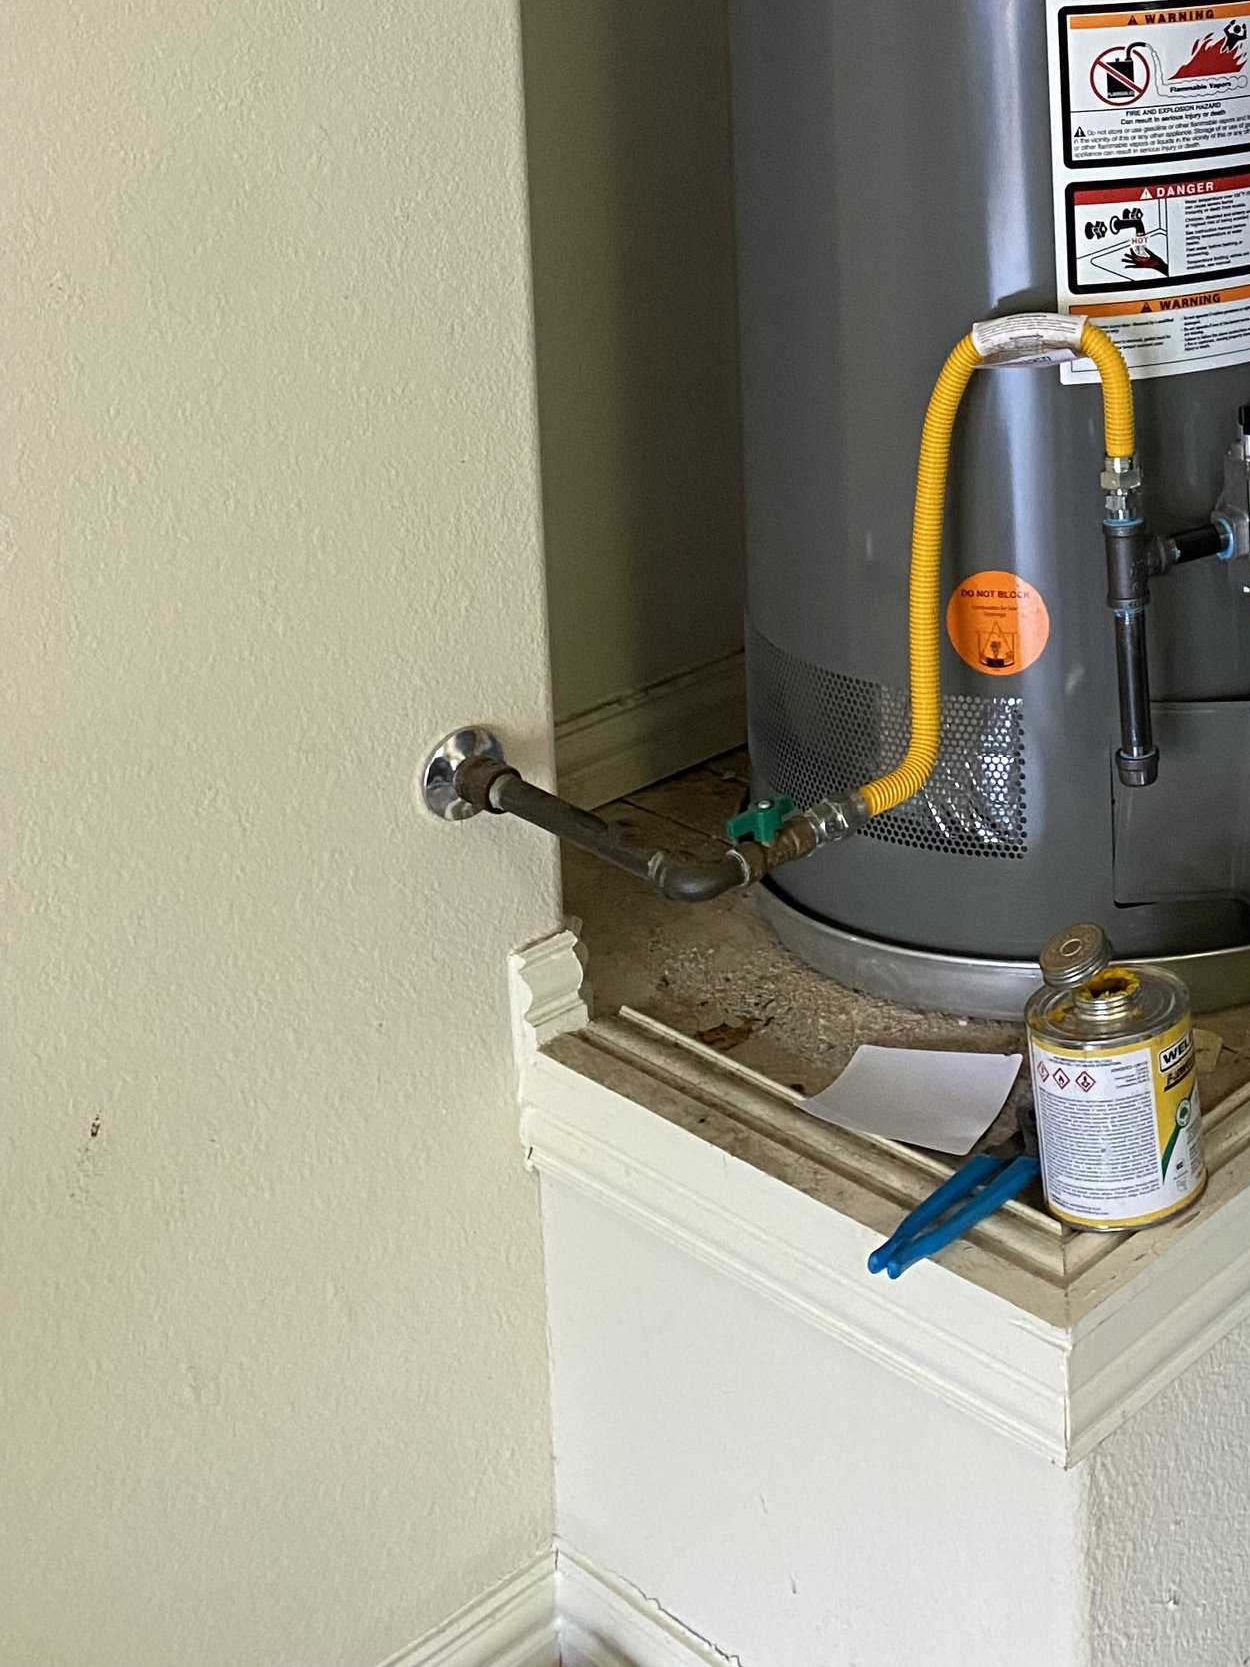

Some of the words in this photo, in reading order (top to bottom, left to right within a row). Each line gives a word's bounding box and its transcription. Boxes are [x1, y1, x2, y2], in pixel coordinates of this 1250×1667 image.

[1145, 9, 1214, 25] WARNING
[1142, 108, 1156, 116] AND
[1156, 181, 1214, 198] DANGER
[1131, 237, 1149, 245] HOT
[1159, 294, 1221, 311] WARNING
[960, 588, 975, 598] DO
[976, 589, 996, 598] NOT
[997, 590, 1031, 599] BLOCK
